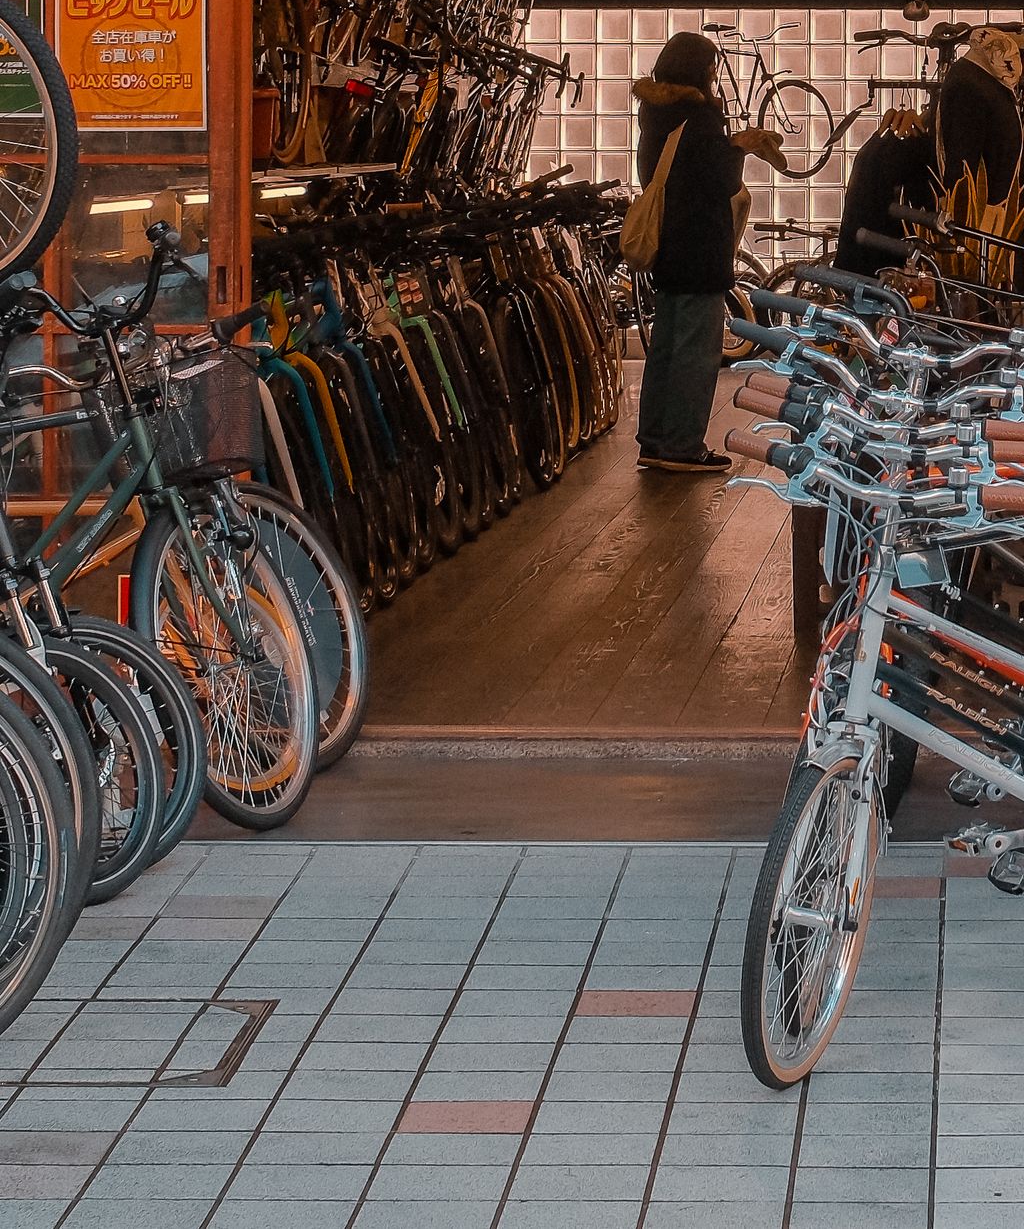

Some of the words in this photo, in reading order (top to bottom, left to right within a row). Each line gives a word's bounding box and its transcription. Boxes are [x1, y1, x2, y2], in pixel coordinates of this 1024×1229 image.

[70, 74, 109, 88] MAX
[111, 74, 147, 88] 50%
[928, 650, 1005, 697] RALEIGH
[926, 687, 1008, 736] RALEIGH
